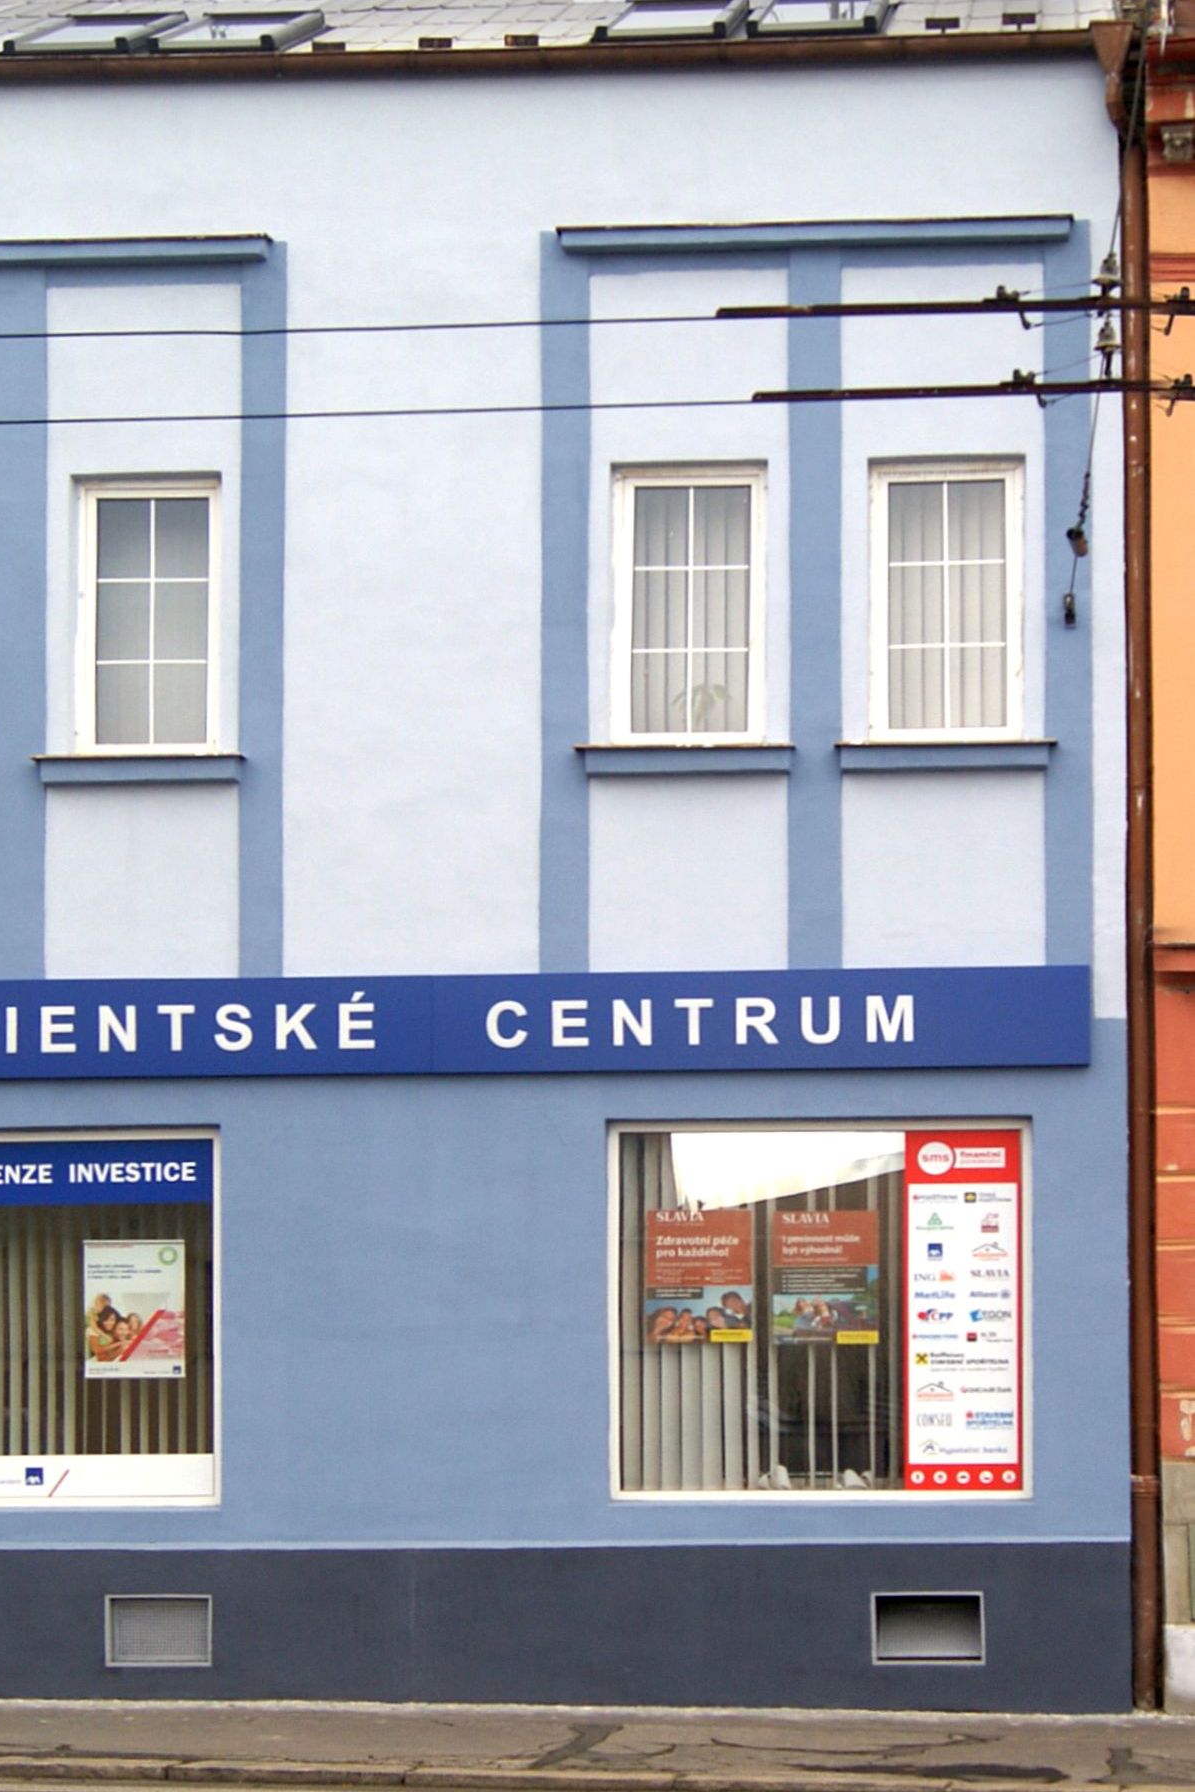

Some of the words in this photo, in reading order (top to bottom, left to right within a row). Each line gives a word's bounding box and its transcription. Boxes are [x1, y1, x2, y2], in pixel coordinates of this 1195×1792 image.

[485, 994, 916, 1049] CENTRUM
[922, 1154, 950, 1163] sms
[68, 1161, 197, 1184] INVESTICE
[655, 1210, 705, 1222] SLAVIA
[782, 1213, 830, 1224] SLAVIA
[656, 1234, 711, 1246] Zdravotní
[713, 1234, 740, 1248] péče
[656, 1249, 676, 1259] pro
[914, 1273, 936, 1282] ING
[970, 1269, 1011, 1278] SLAVIA
